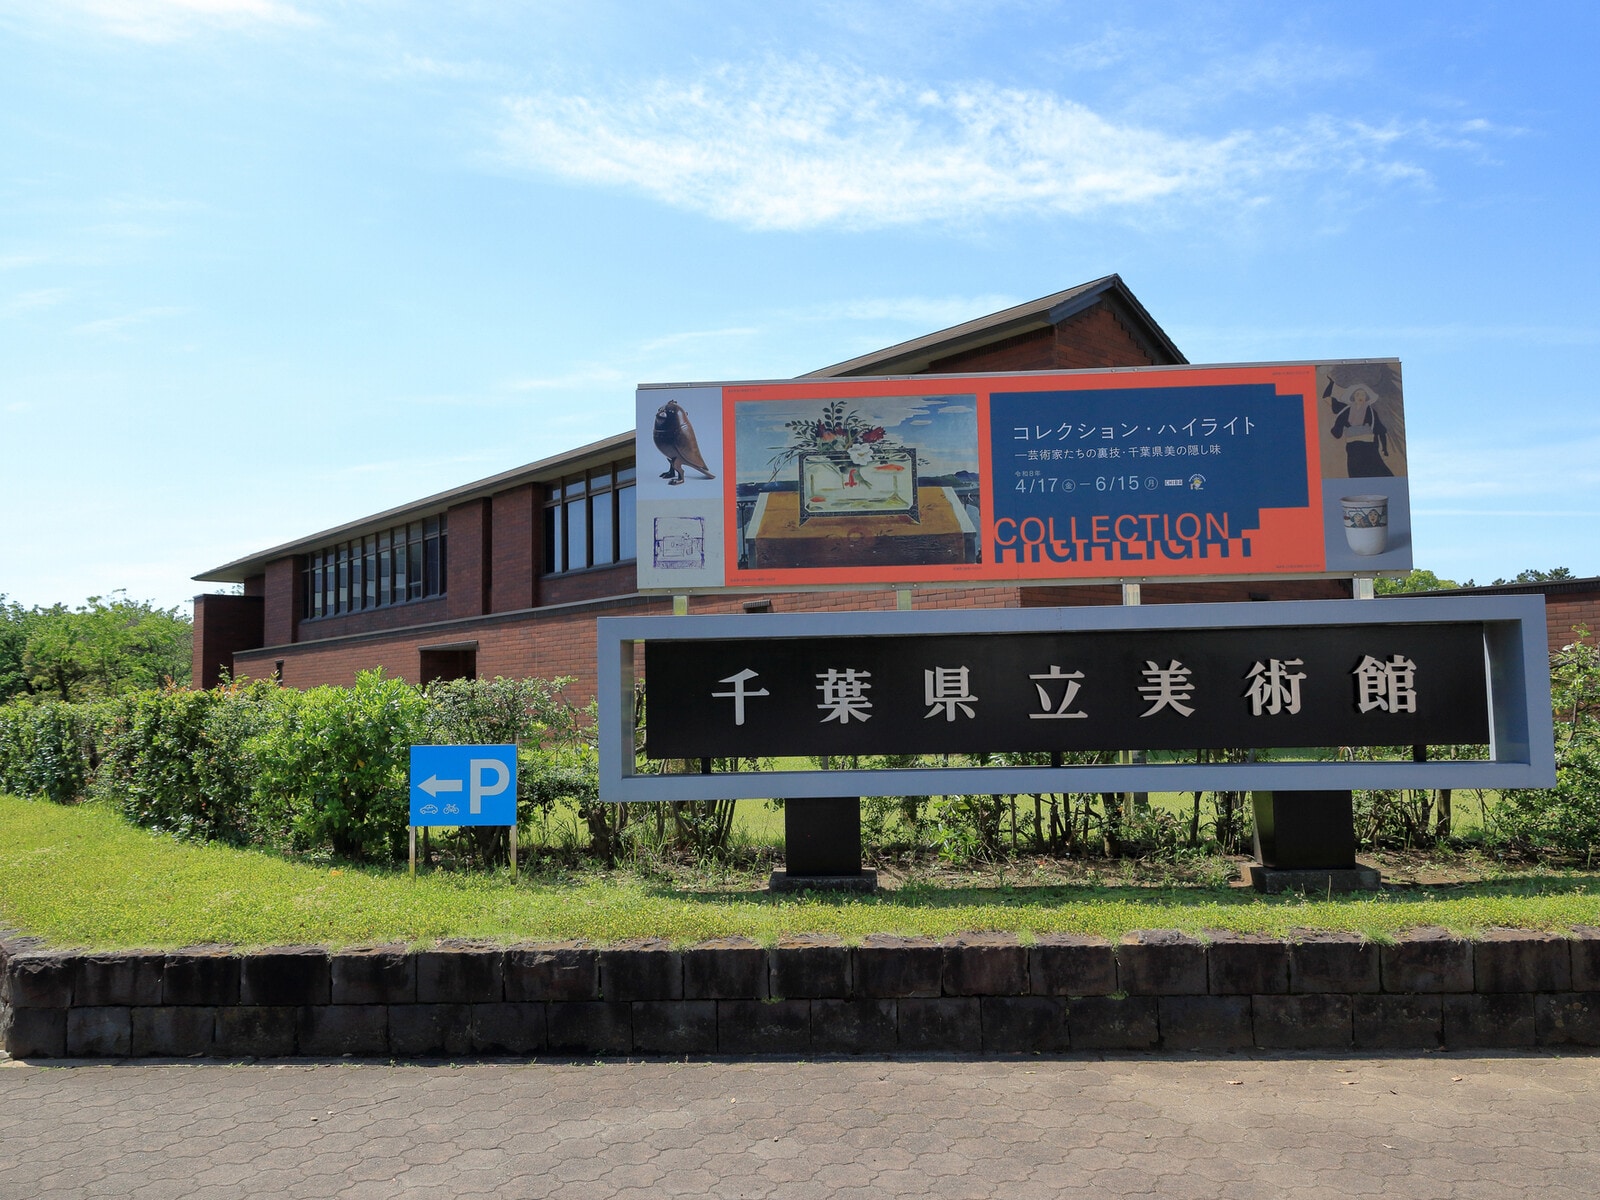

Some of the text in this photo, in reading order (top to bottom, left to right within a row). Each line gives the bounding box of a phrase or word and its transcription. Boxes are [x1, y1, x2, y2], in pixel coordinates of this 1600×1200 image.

[1013, 416, 1255, 441] コレクション・ハイライト
[994, 512, 1229, 546] COLLECTION
[711, 654, 1418, 727] 千葉県立美術館
[470, 759, 510, 814] P
